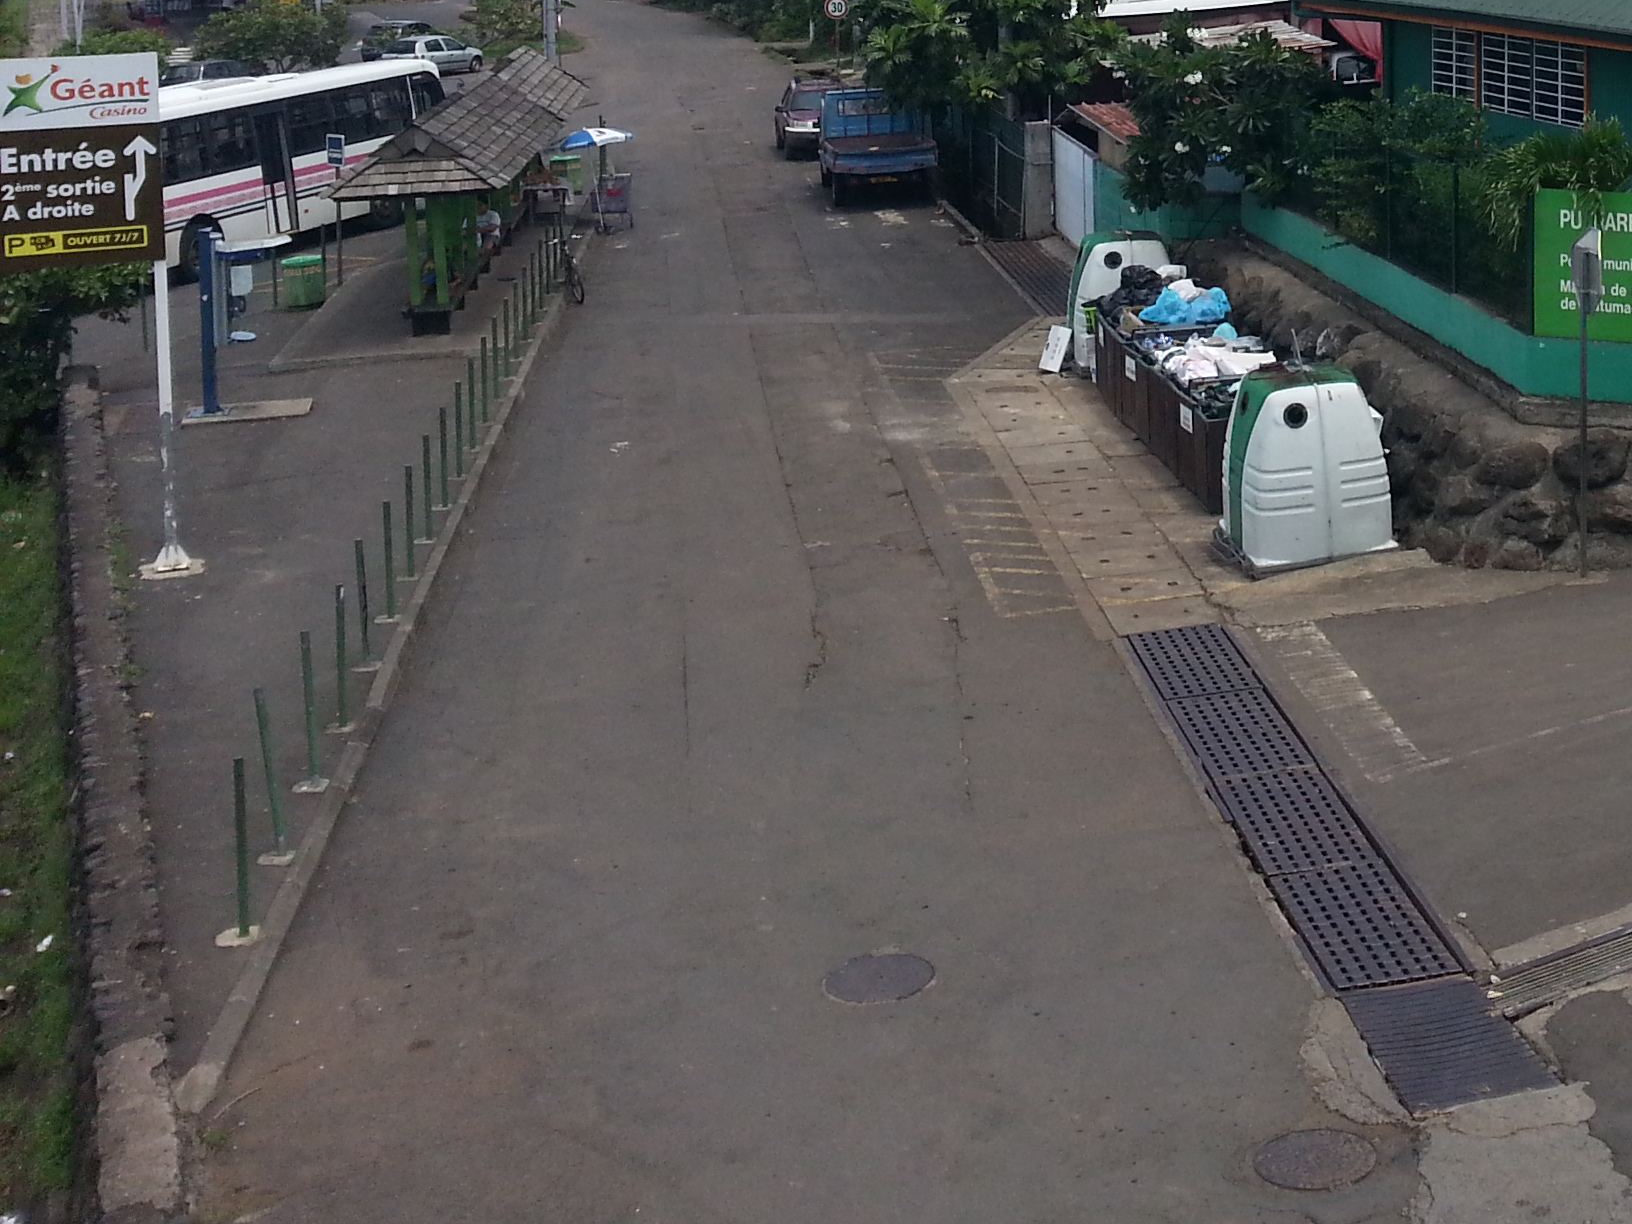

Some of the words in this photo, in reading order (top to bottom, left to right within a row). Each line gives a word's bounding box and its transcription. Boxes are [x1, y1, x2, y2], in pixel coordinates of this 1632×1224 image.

[831, 2, 843, 13] 30
[50, 76, 150, 101] Géant
[89, 105, 147, 120] Casino
[0, 142, 116, 174] Entrée
[1, 182, 42, 201] 2ème
[46, 176, 116, 198] sortie
[2, 204, 20, 222] A
[27, 200, 95, 220] droite
[67, 235, 112, 246] OUVERT
[1610, 283, 1627, 297] de
[1560, 297, 1577, 310] de
